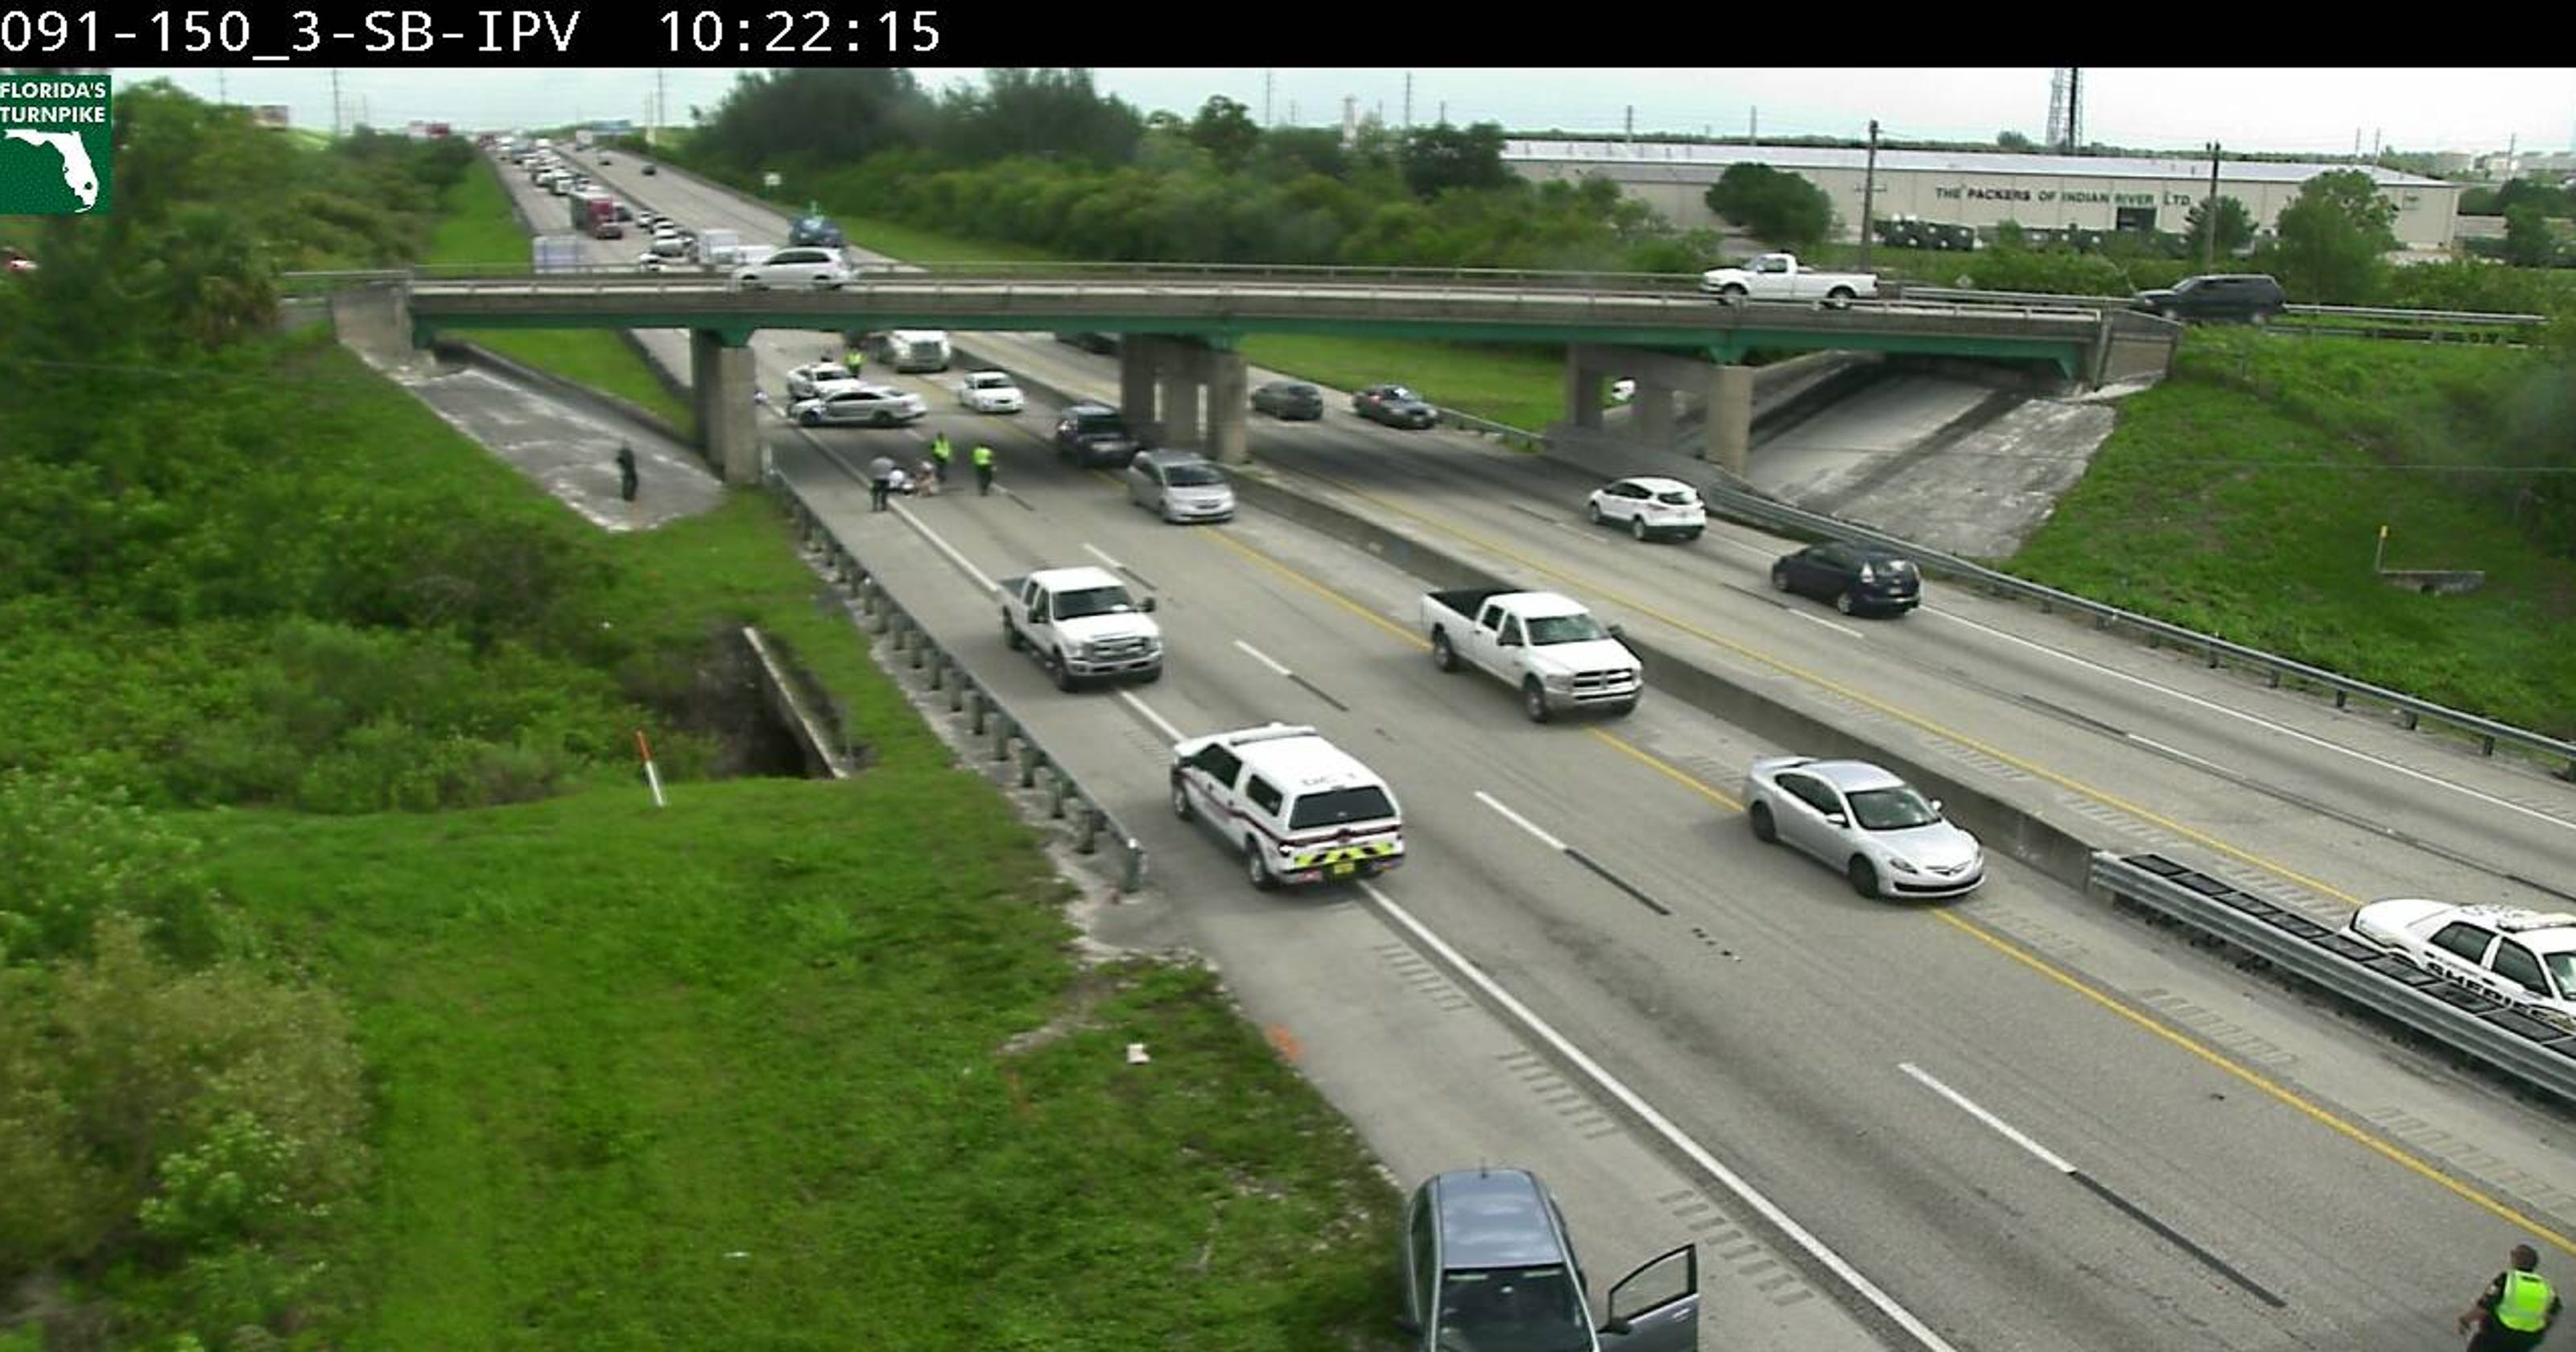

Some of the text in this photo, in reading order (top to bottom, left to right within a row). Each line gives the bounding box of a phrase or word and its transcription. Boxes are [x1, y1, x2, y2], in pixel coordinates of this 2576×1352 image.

[1935, 187, 2191, 205] THE PACKERS OF INDIAN RIVER LTD
